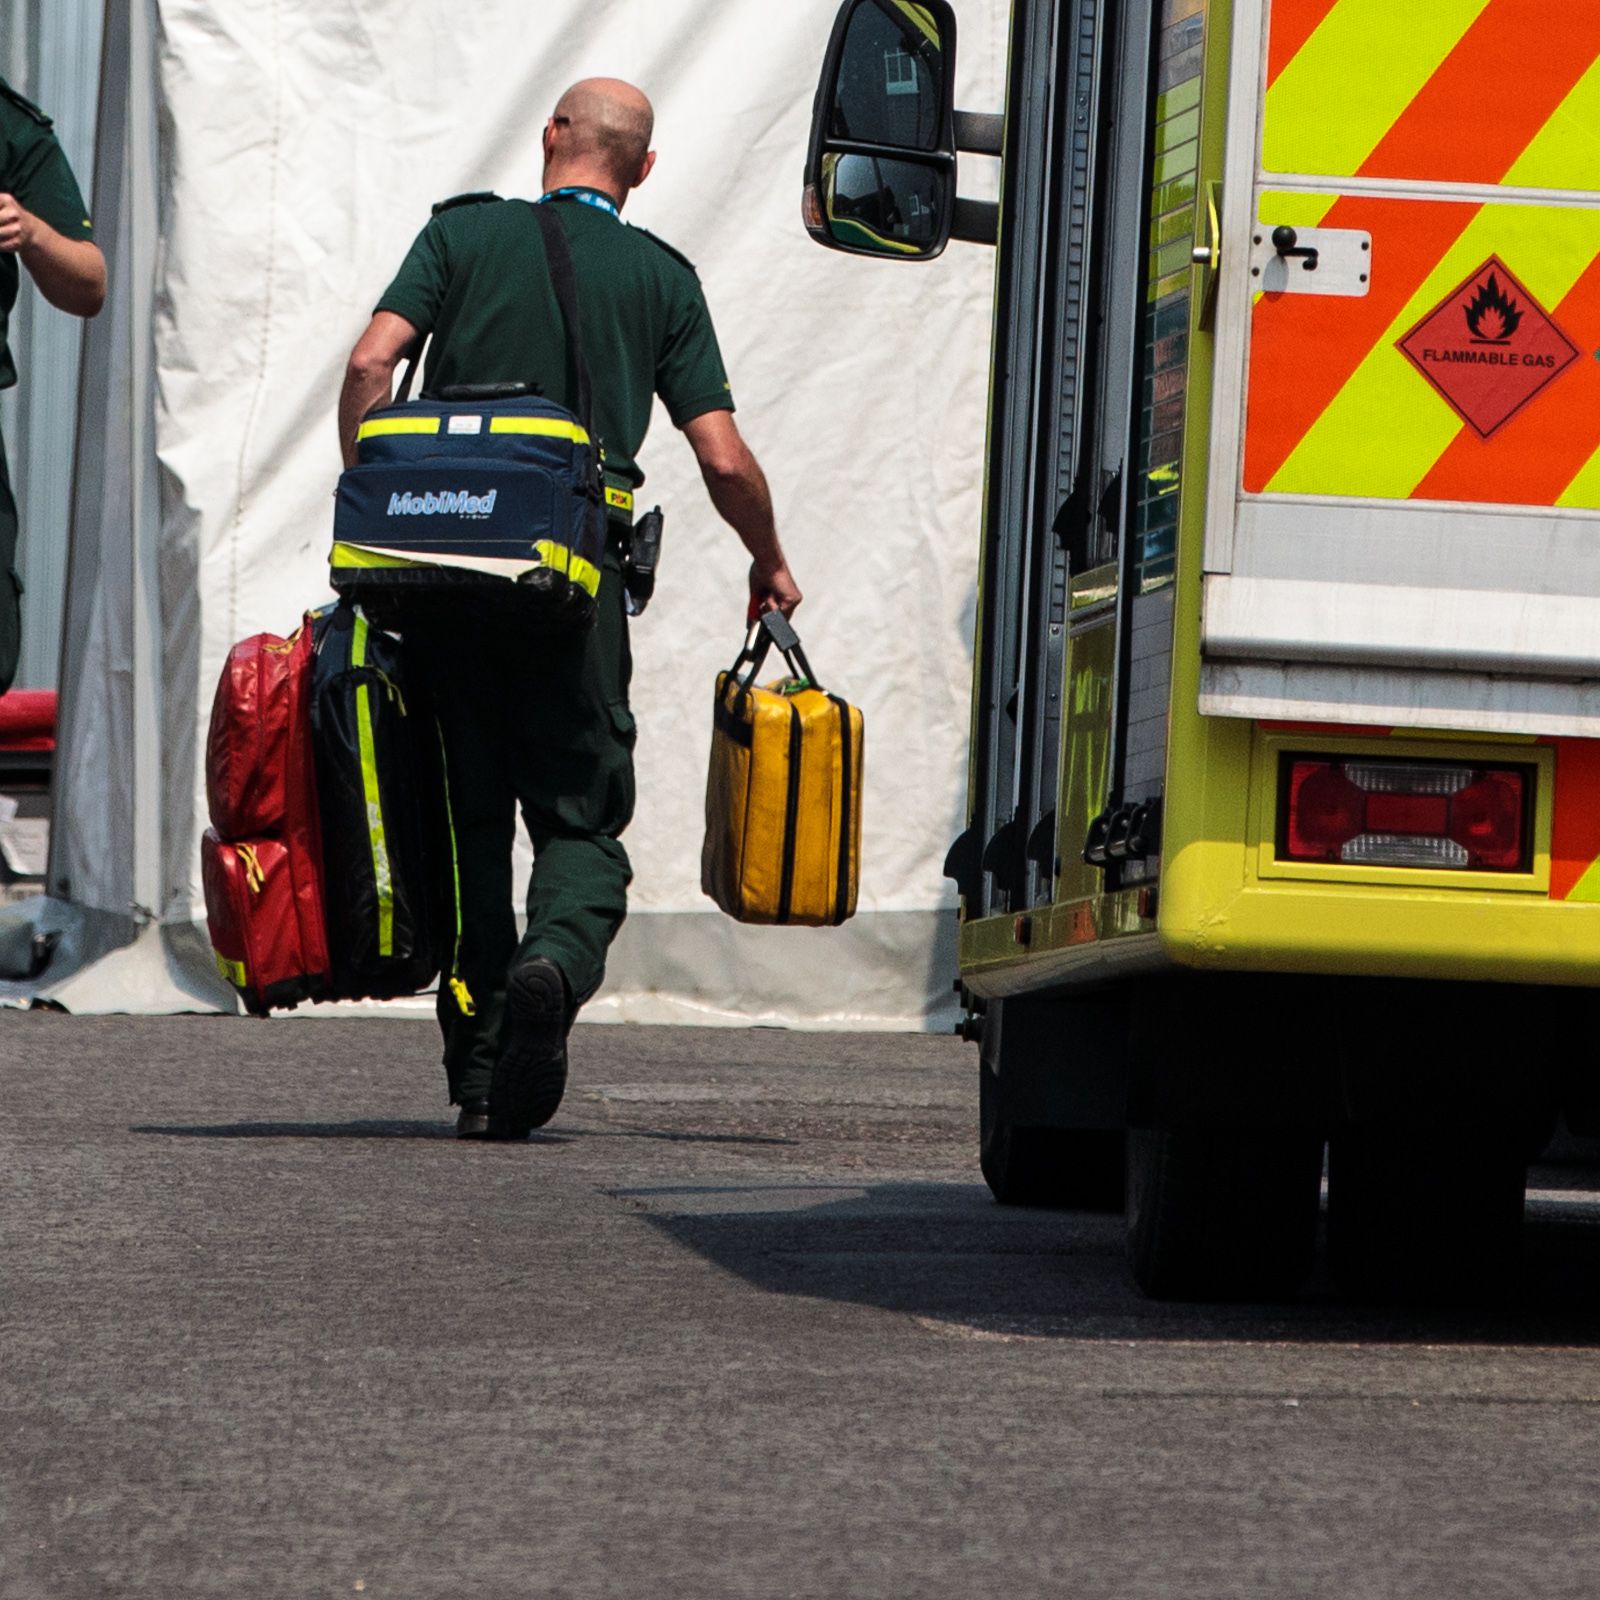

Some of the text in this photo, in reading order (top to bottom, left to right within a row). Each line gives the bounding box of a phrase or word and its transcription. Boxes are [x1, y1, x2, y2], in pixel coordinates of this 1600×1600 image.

[1423, 349, 1556, 368] FLAMMABLE GAS
[386, 489, 498, 516] MobiMed
